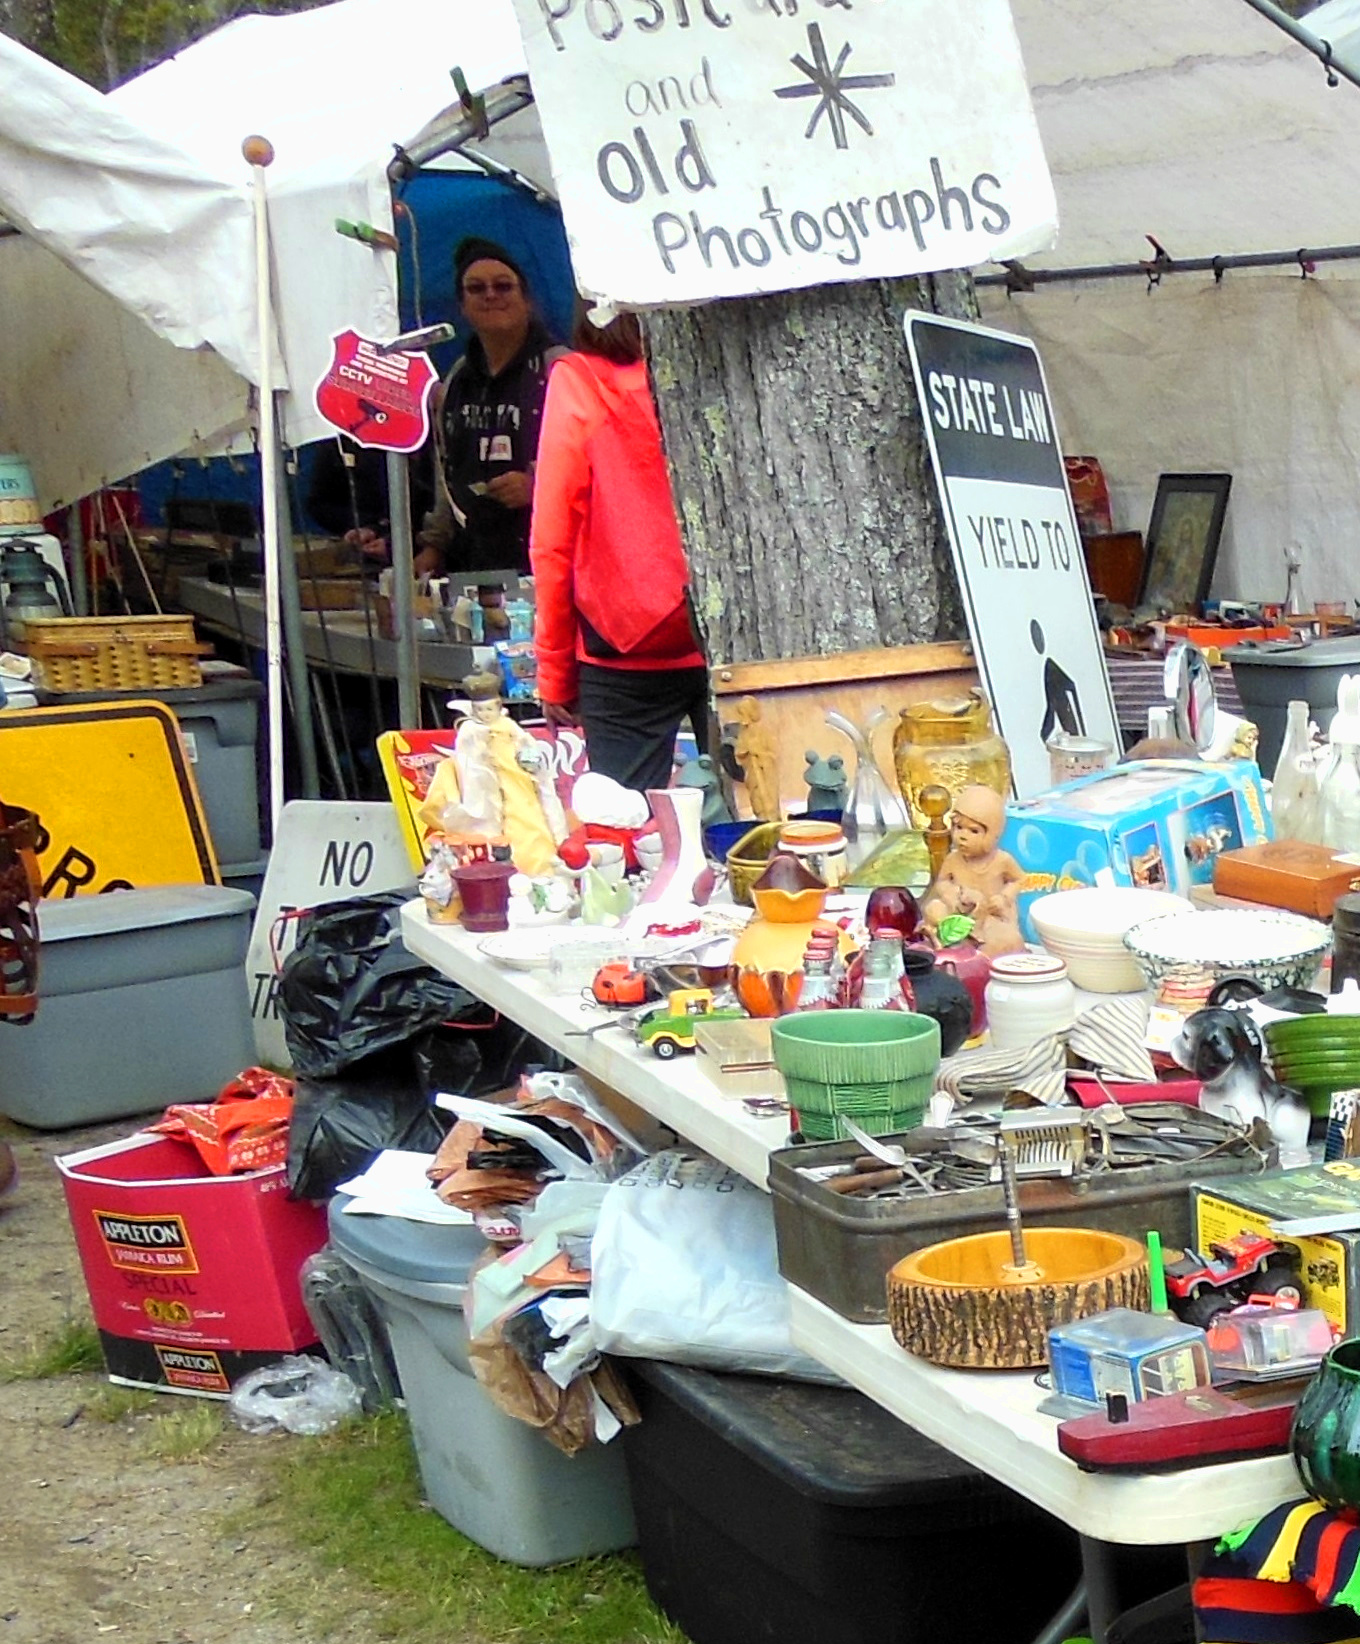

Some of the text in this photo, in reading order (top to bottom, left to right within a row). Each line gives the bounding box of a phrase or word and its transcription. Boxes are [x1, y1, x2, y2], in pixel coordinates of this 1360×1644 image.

[626, 56, 722, 116] and
[597, 119, 717, 204] Old
[653, 157, 1010, 274] Photographs
[340, 365, 373, 385] CCTV
[929, 371, 1050, 444] STATE LAW
[968, 515, 1070, 572] YIELD TO
[320, 841, 374, 887] NO
[103, 1220, 181, 1244] APPLETON
[121, 1273, 198, 1296] SPECIAL
